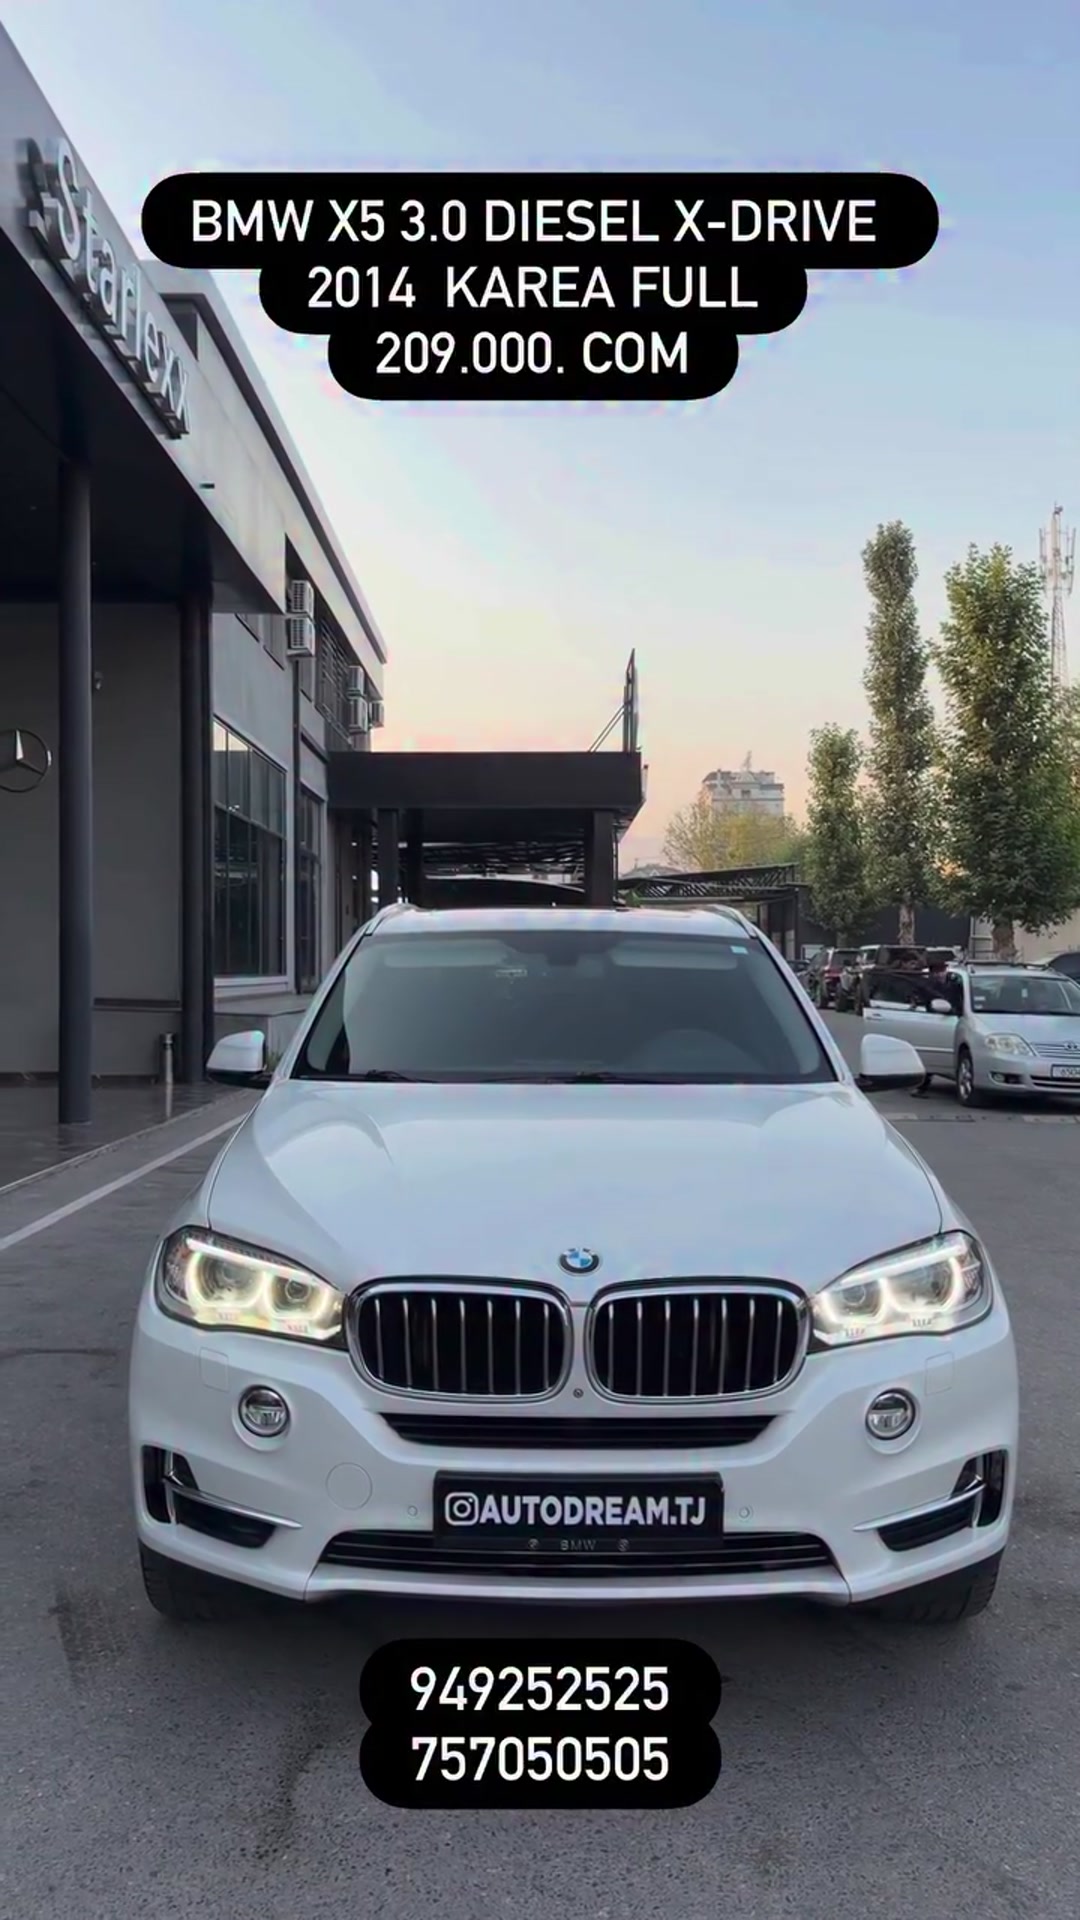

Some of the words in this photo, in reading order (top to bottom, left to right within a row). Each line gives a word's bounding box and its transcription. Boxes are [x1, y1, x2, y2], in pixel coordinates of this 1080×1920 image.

[30, 136, 190, 437] Starlexx
[480, 1493, 706, 1526] AUTODREAM.TJ
[560, 1539, 597, 1551] BMW
